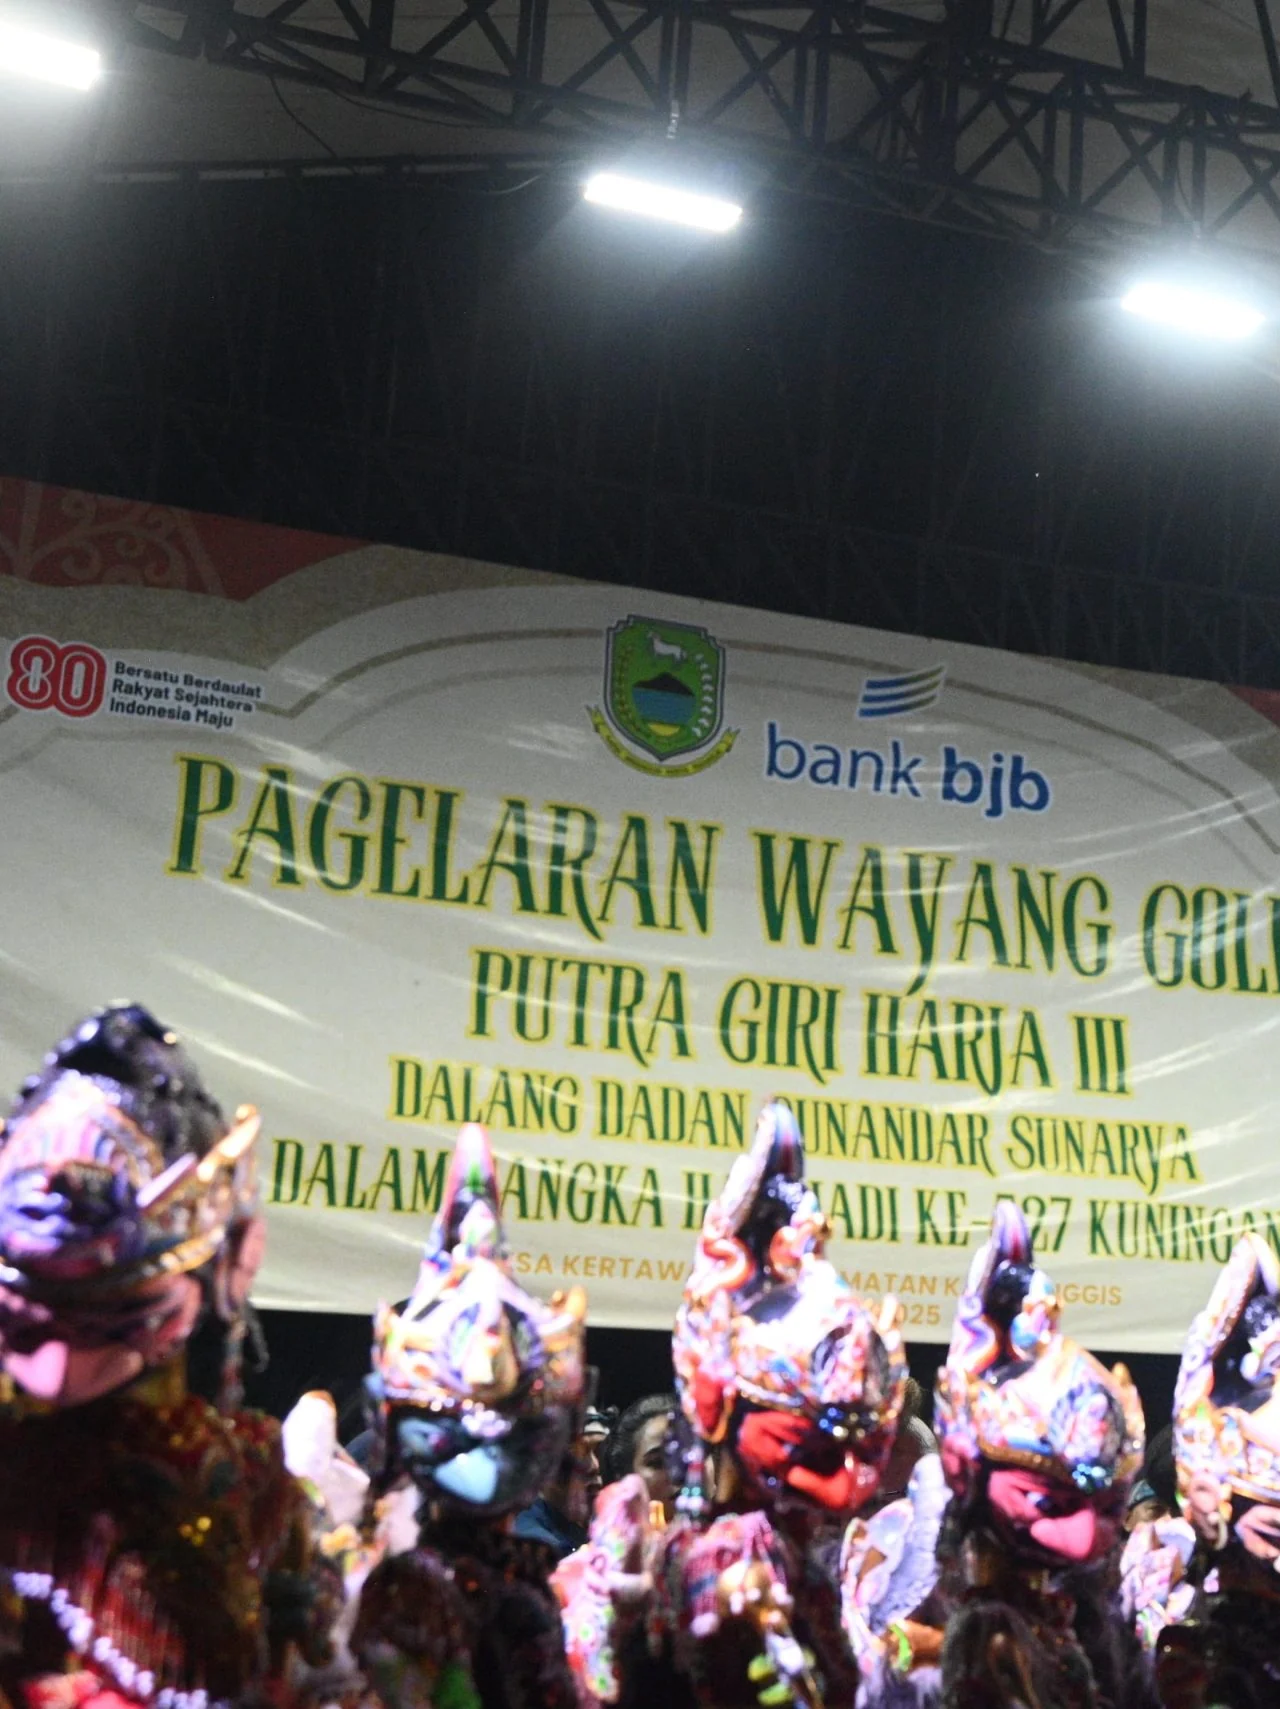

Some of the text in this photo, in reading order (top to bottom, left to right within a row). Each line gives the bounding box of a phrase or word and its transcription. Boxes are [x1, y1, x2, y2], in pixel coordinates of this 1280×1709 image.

[7, 636, 107, 717] 80
[109, 699, 234, 730] Indonesia Maju
[112, 679, 254, 713] Rakyat Sejahtera
[114, 661, 262, 699] Bersatu Berdaulat
[765, 721, 922, 798] bank
[941, 746, 1050, 817] bjb
[170, 756, 721, 942] PAGELARAN
[752, 830, 1112, 995] WAYANG
[468, 949, 1130, 1096] PUTRA GIRI HARJA III
[393, 1058, 1198, 1196] DALANG DADAN UNANDAR SUNARYA
[272, 1139, 449, 1214] DALAM
[497, 1156, 664, 1228] ANGKA
